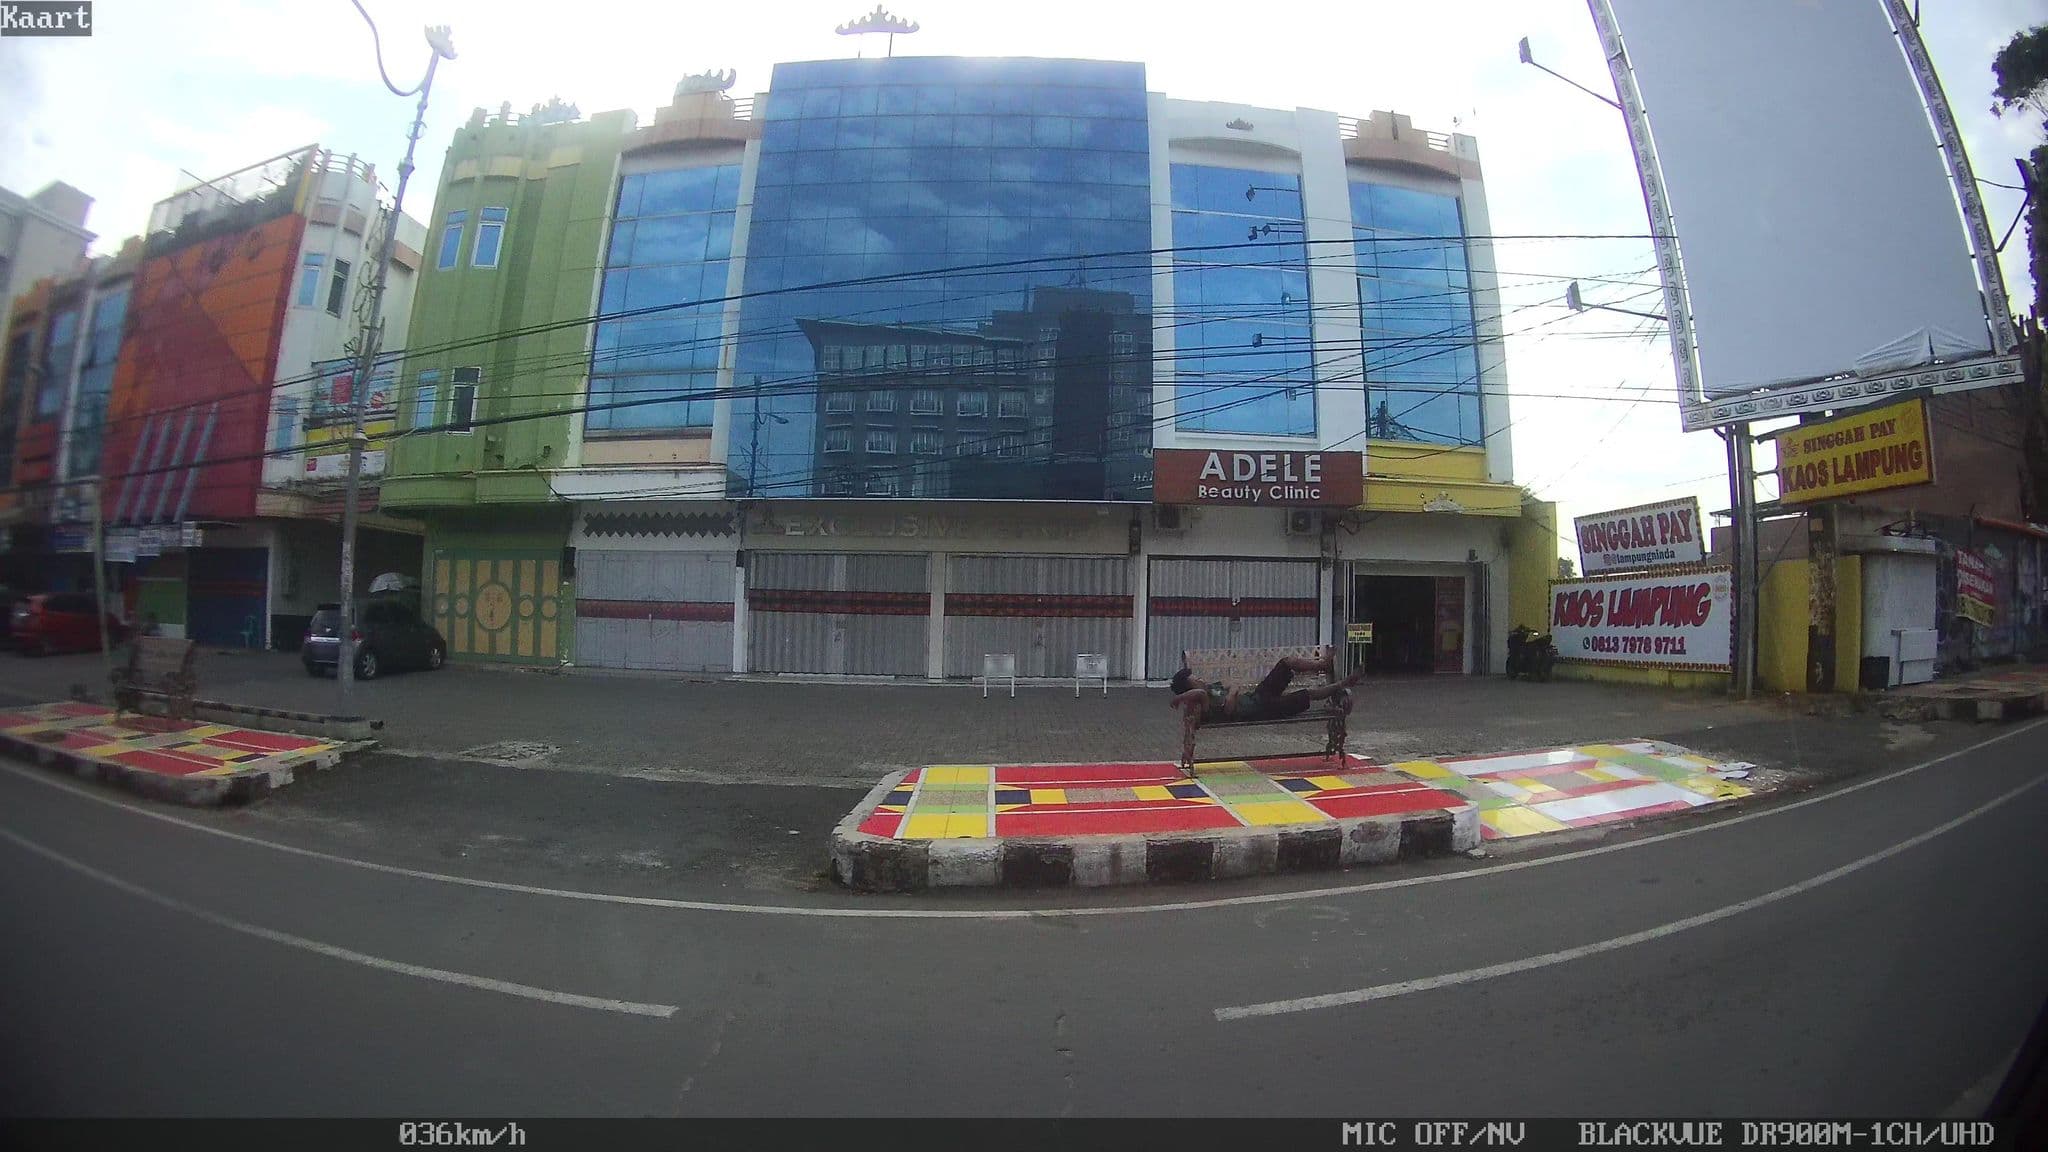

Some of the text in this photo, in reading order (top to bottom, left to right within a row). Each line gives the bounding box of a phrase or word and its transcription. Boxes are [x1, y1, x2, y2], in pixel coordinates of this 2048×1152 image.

[1804, 418, 1897, 453] SINGGAH PAY
[1200, 452, 1322, 483] ADELE
[1782, 440, 1923, 494] KAOS LAMPUNG
[1198, 485, 1321, 502] Beauty Clinic
[1580, 508, 1693, 554] SINGGAH PAY
[1553, 589, 1604, 628] KAOS
[1606, 582, 1712, 628] LAMPUNG
[1592, 636, 1686, 655] 0813 7978 9711
